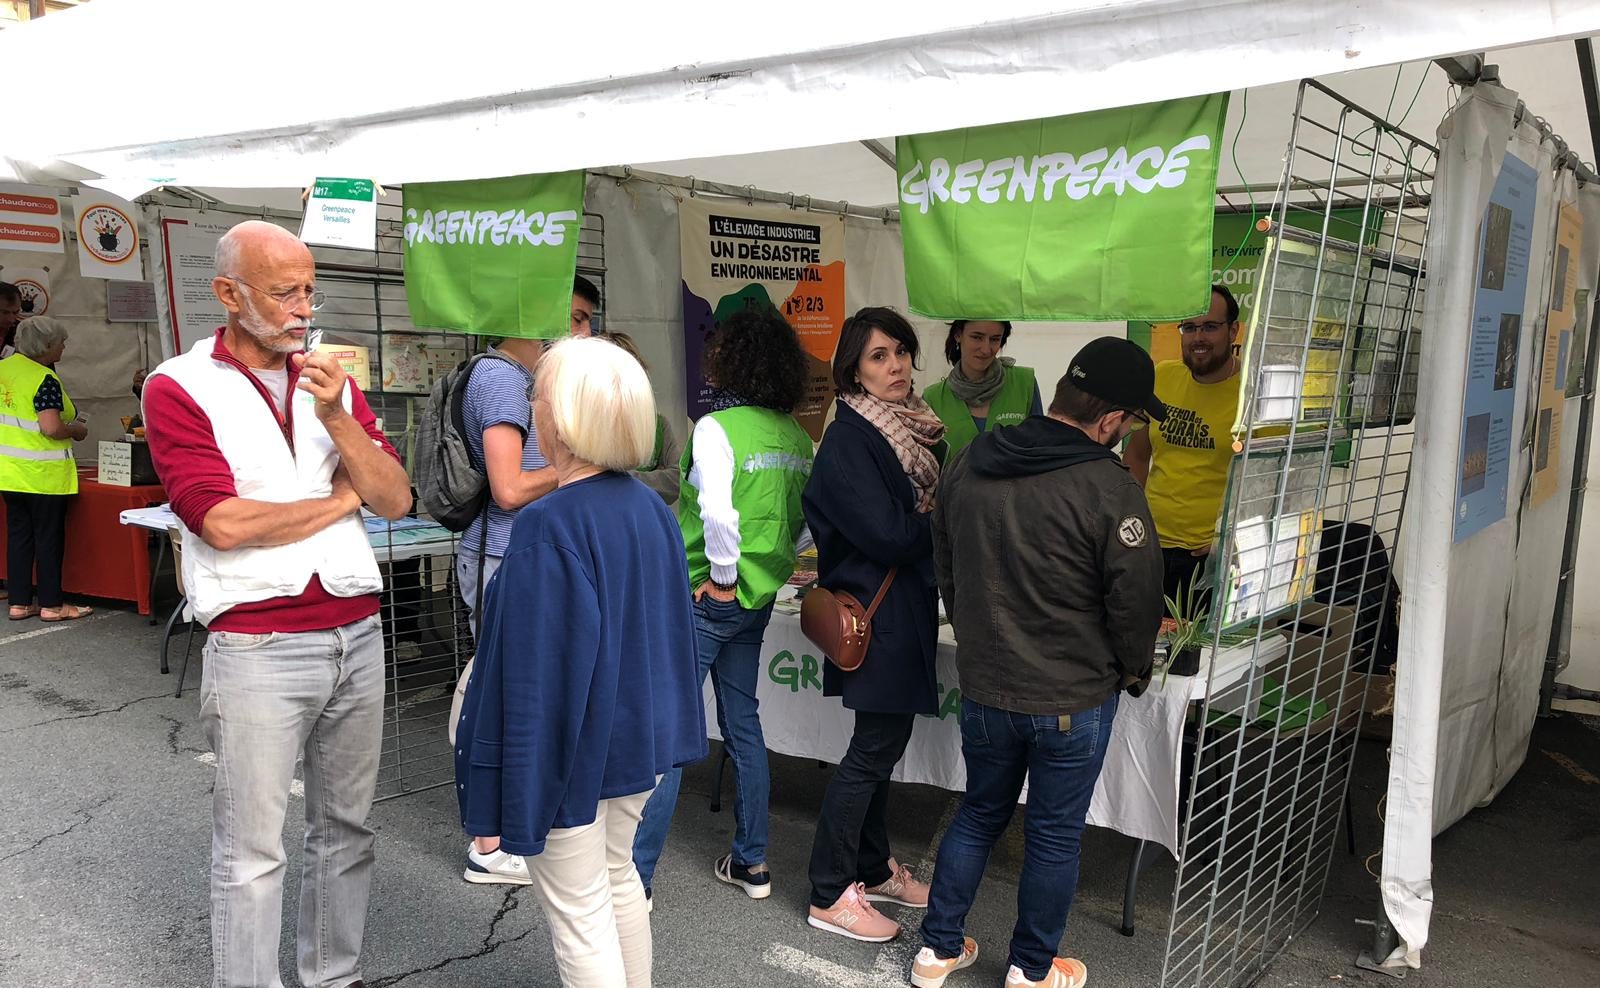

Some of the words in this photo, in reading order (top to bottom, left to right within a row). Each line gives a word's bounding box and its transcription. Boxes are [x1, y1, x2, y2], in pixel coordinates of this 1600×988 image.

[901, 134, 1211, 214] GREENPEACE
[314, 186, 329, 197] M17
[321, 203, 356, 215] Greenpeace
[404, 207, 577, 248] GREENPEACE
[714, 219, 766, 237] L'ÉLEVAGE
[767, 226, 817, 241] INDUSTRIEL
[710, 240, 735, 259] UN
[738, 240, 821, 264] DÉSASTRE
[711, 262, 823, 282] ENVIRONNEMENTAL
[806, 296, 825, 313] 2/3
[1159, 415, 1211, 438] CORAIS
